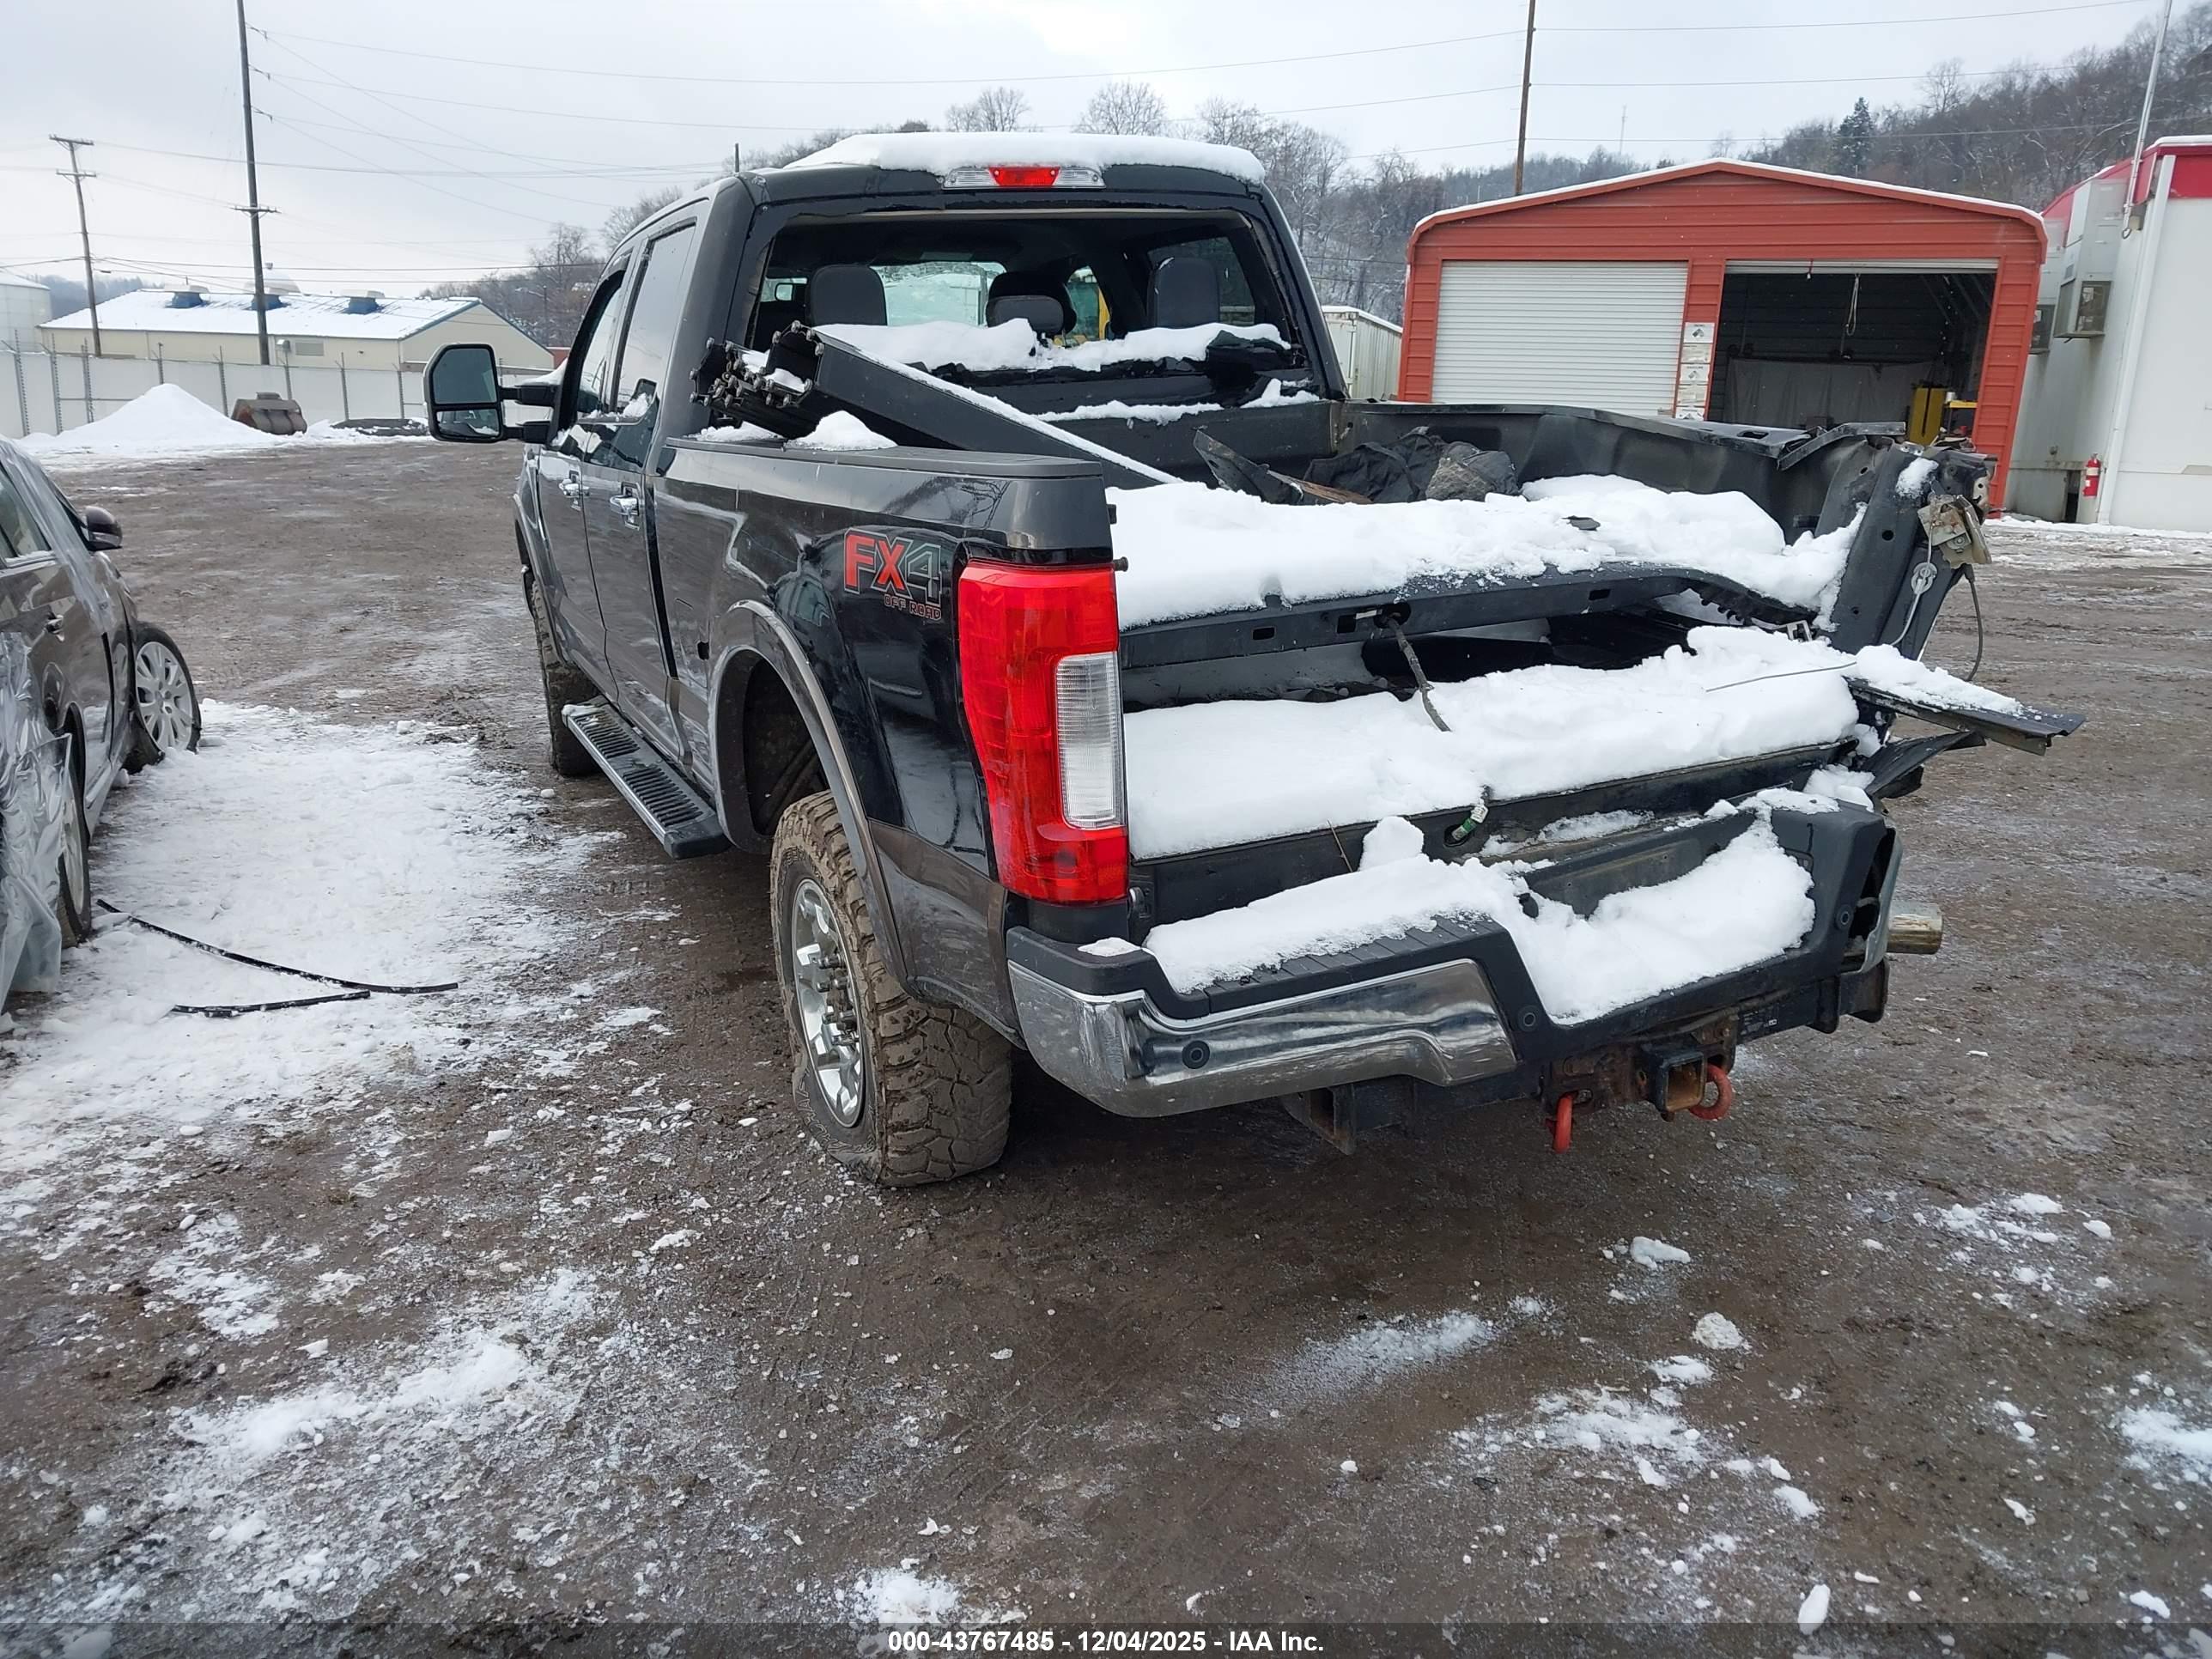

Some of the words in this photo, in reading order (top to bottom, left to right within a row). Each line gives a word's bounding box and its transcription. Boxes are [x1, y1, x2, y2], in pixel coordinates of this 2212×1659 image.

[844, 527, 942, 607] FX4
[884, 593, 906, 611] OFF
[908, 601, 942, 621] ROAD
